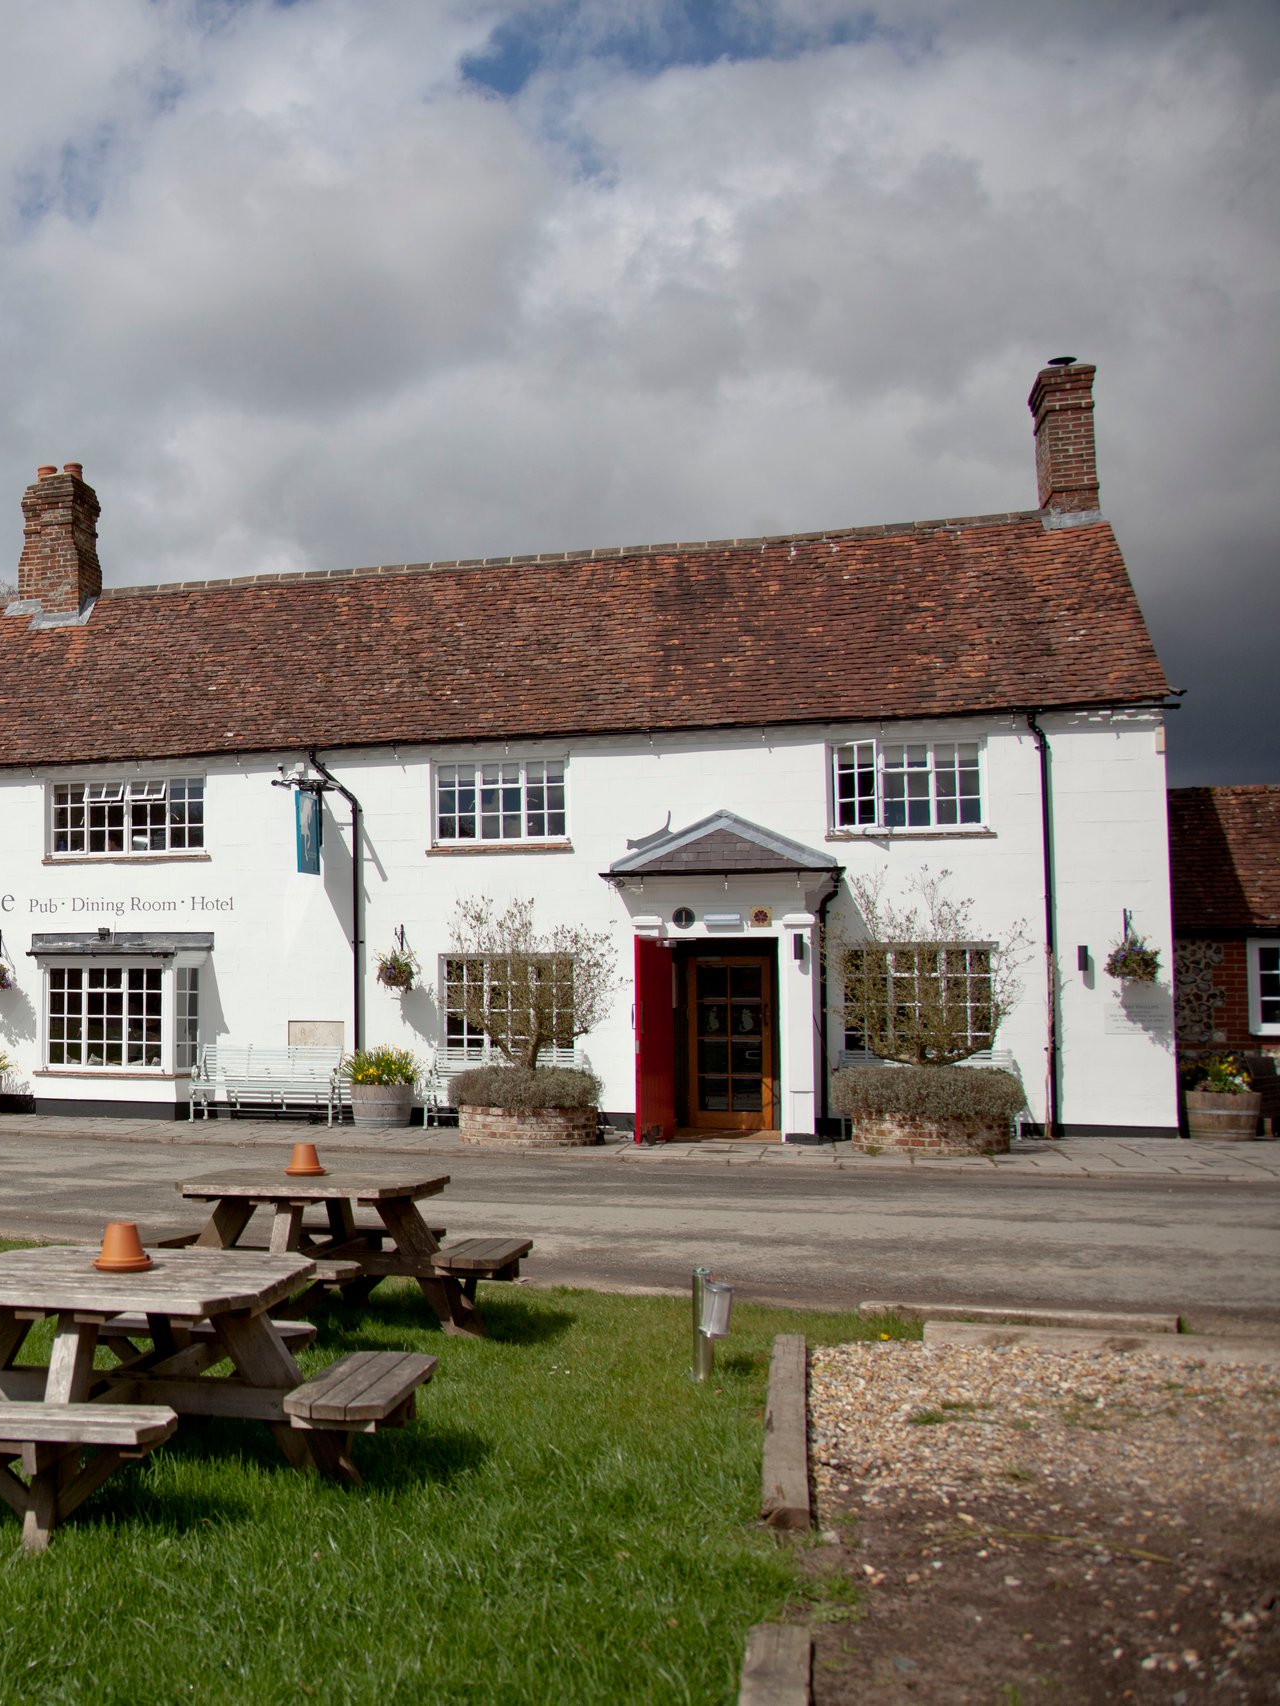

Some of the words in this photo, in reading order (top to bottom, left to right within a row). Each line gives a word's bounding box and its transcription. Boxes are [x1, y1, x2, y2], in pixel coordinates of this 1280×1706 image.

[29, 898, 58, 913] Pub
[71, 897, 125, 916] Dining
[130, 896, 177, 911] Room
[190, 896, 234, 911] Hotel
